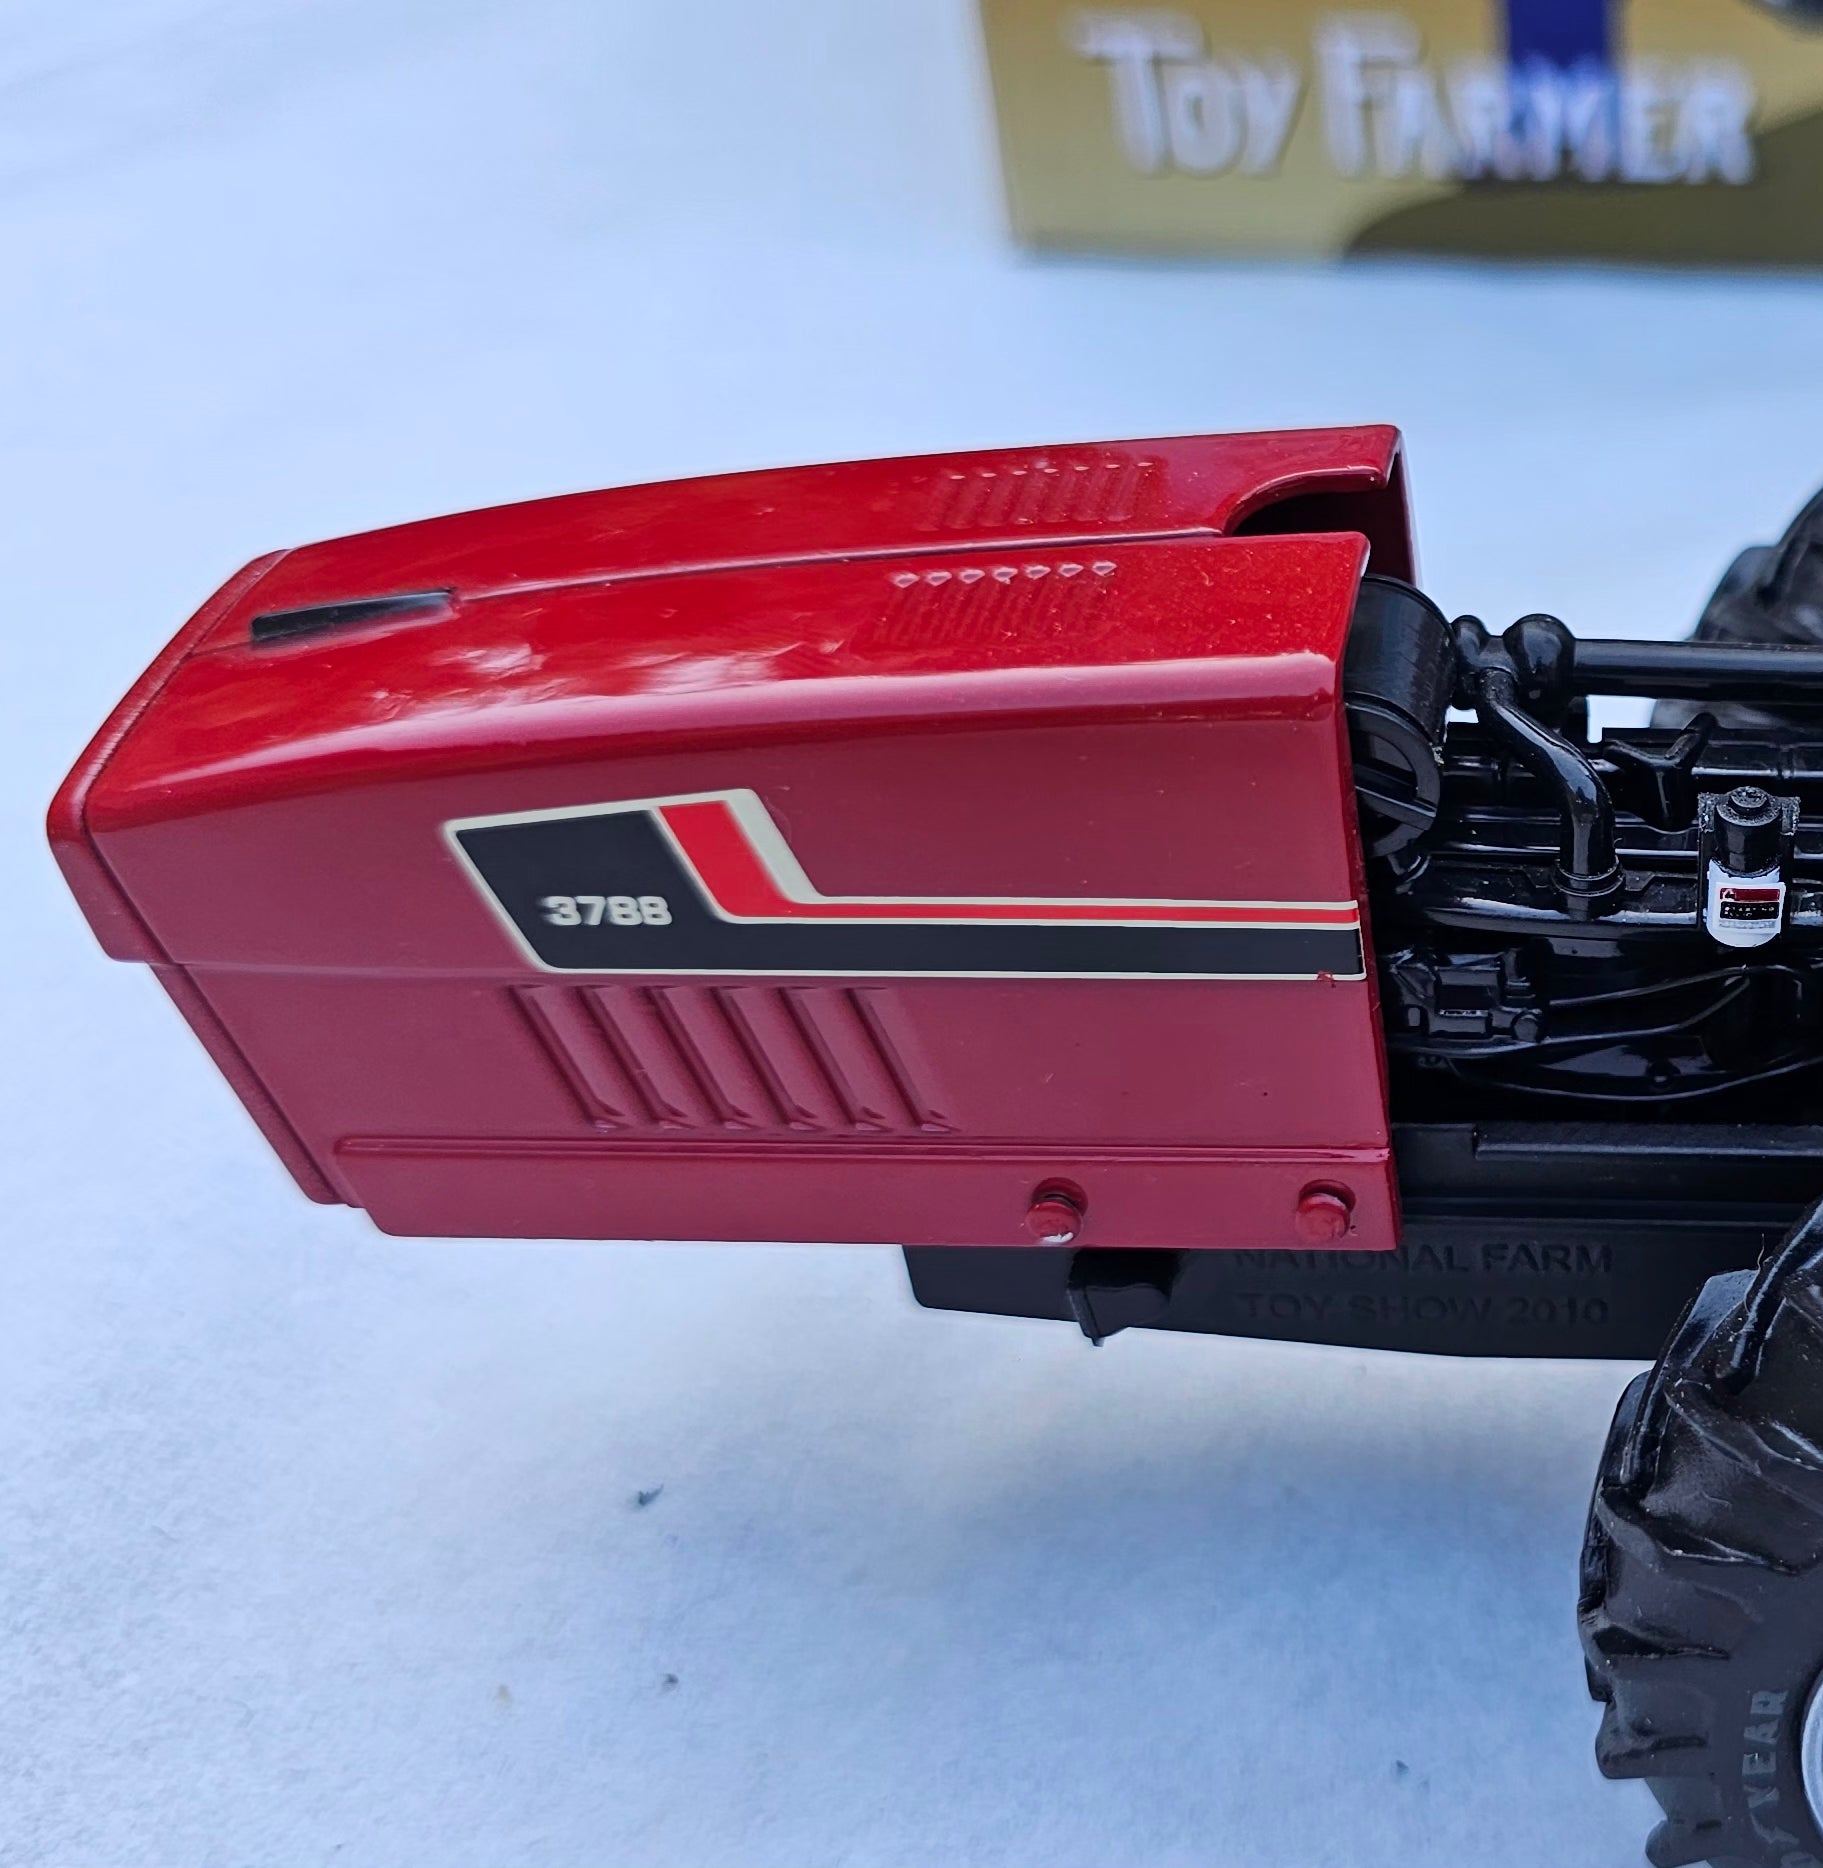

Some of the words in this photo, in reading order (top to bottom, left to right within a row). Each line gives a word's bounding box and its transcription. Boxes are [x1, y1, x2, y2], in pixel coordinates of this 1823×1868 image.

[1312, 12, 1755, 184] FARMER
[539, 895, 672, 926] 3788
[1233, 1243, 1470, 1274] NATIONAL
[1480, 1243, 1614, 1274] FARM
[1235, 1292, 1334, 1320] TOY
[1348, 1293, 1496, 1325] SHOW
[1506, 1297, 1612, 1327] 2010
